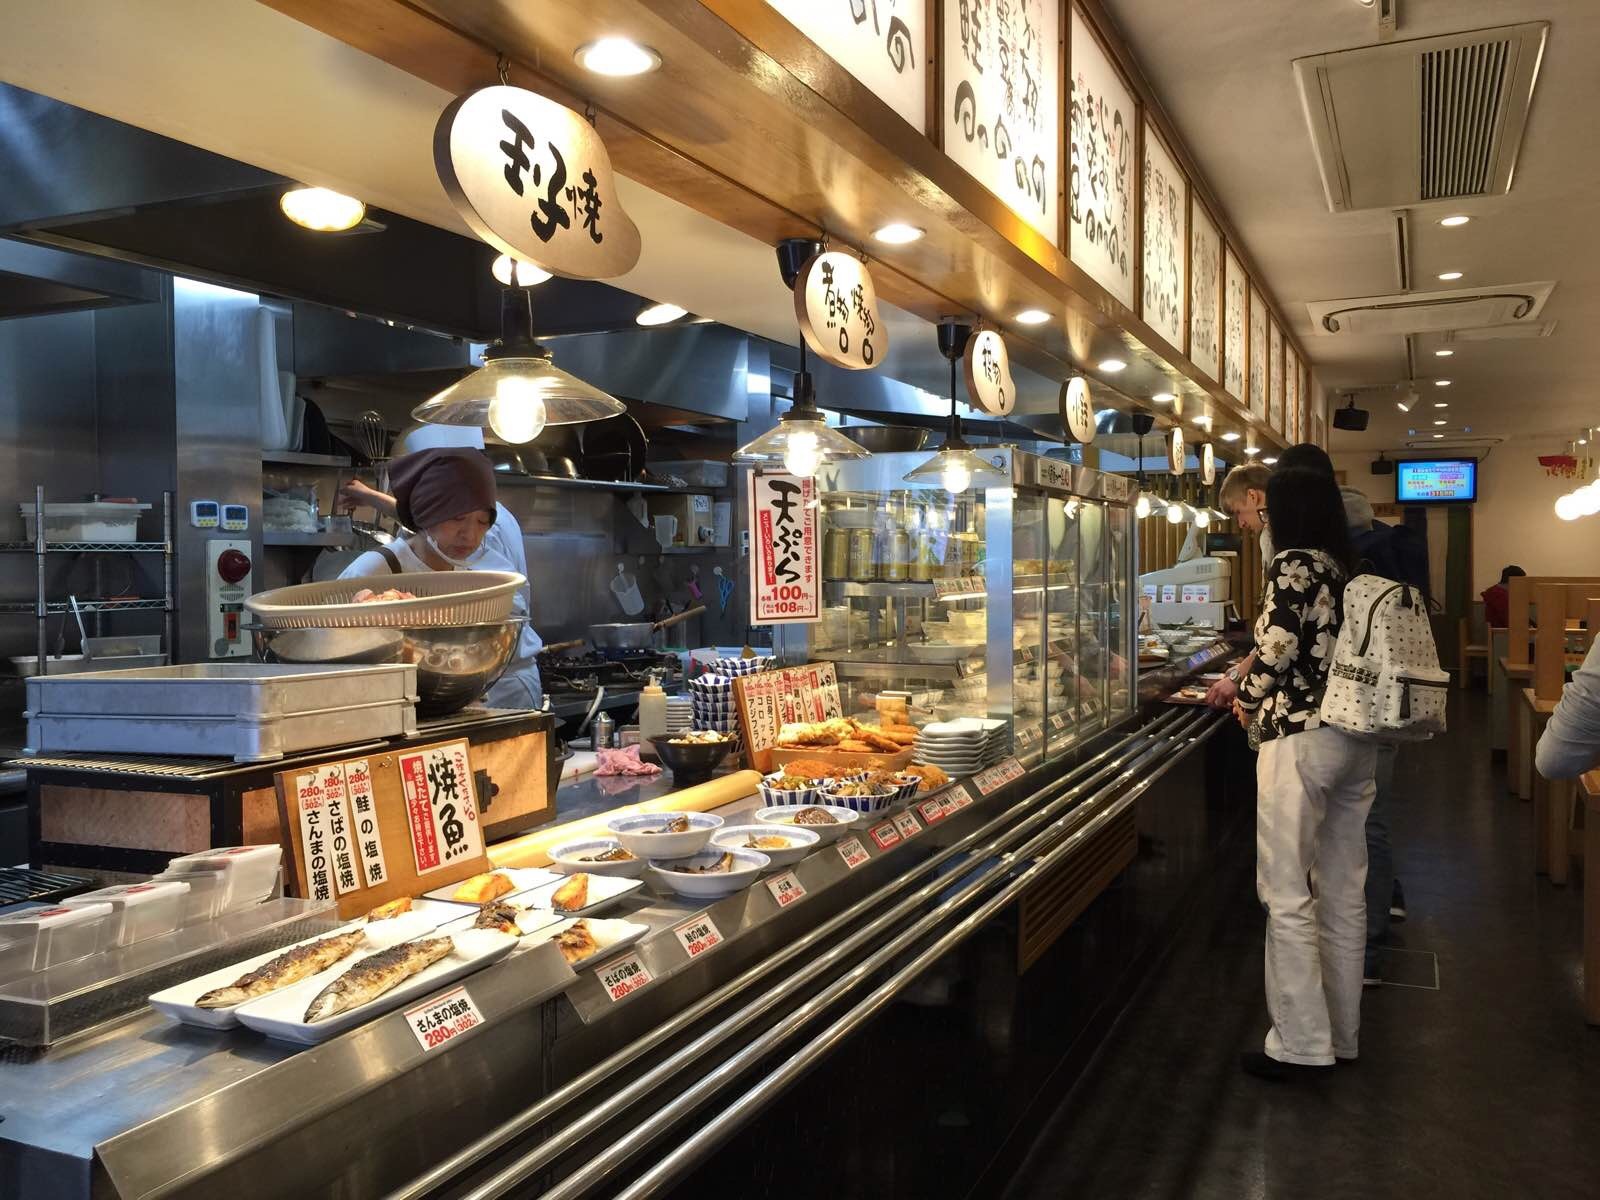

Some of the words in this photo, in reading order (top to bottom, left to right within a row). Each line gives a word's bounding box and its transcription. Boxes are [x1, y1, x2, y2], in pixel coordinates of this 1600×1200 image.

[499, 109, 603, 244] 玉子焼
[767, 479, 803, 584] 天ぷら
[747, 698, 760, 749] アジフライ
[757, 697, 767, 746] コロッケ
[300, 785, 325, 798] 280円
[428, 757, 469, 860] 焼魚
[306, 810, 330, 901] さんまの塩焼
[328, 800, 355, 888] さばの塩焼
[355, 794, 383, 882] 鮭の塩焼
[416, 998, 471, 1033] さんまの塩焼
[604, 961, 641, 988] さばの塩焼
